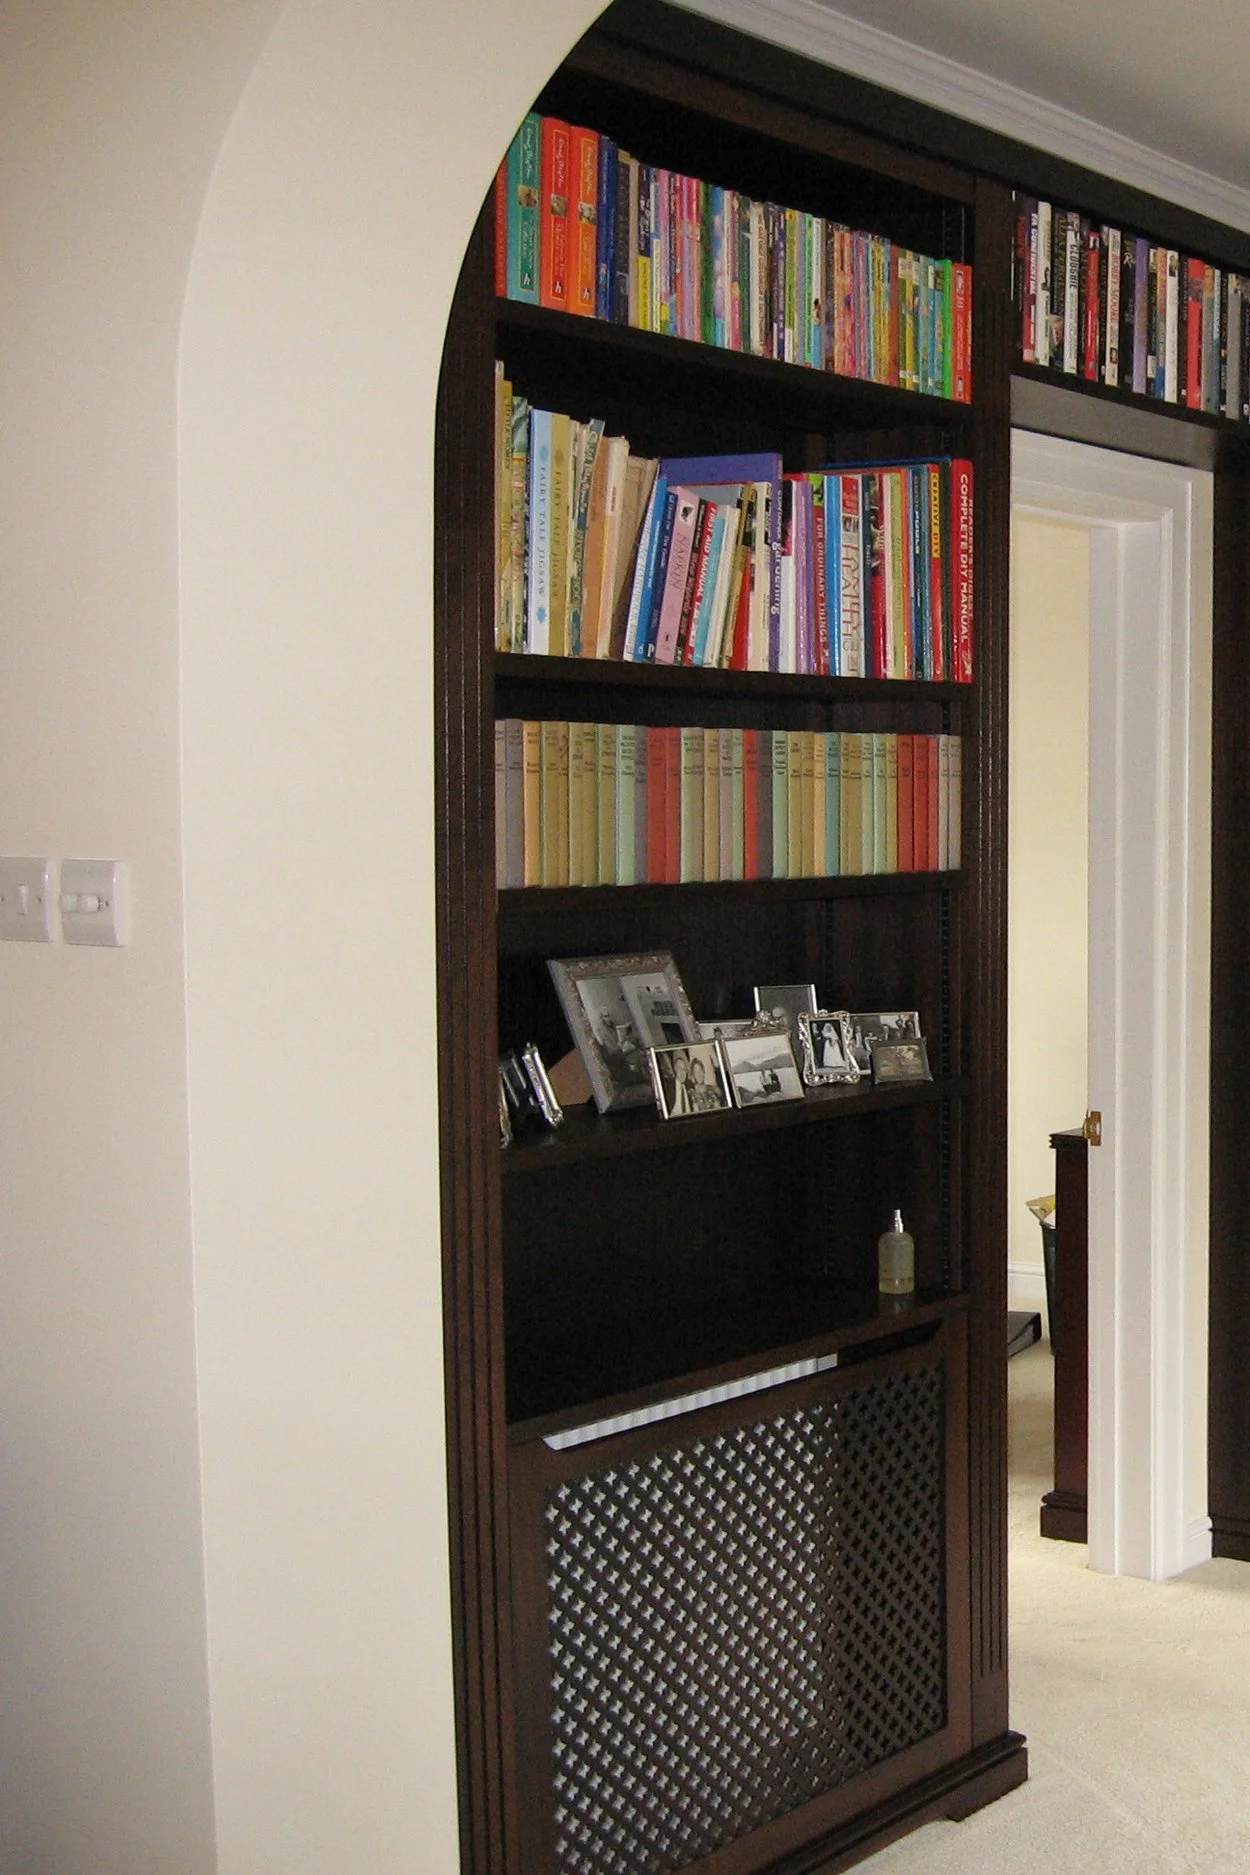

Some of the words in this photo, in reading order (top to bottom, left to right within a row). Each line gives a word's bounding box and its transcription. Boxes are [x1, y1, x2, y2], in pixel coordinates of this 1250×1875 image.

[1058, 216, 1067, 249] ALEX
[1057, 251, 1066, 315] FERGUSON
[1069, 243, 1078, 289] CLOUGHIE
[1111, 253, 1120, 287] BOBBY
[1110, 288, 1120, 324] MOORE
[538, 465, 547, 505] FAIRY
[553, 470, 562, 510] FAIRY
[931, 473, 939, 528] CREATIVE
[538, 511, 547, 541] TALE
[552, 515, 562, 545] TALE
[706, 506, 717, 533] FIRST
[816, 517, 824, 539] FOR
[960, 473, 969, 550] COMPLETE
[670, 532, 688, 591] NAPKIN
[703, 534, 712, 553] AID
[932, 532, 940, 556] DIY
[537, 546, 547, 598] JIGSAW
[551, 549, 561, 601] JIGSAW
[696, 554, 710, 598] MANUAL
[772, 541, 784, 615] gardening
[817, 541, 826, 598] ORDINARY
[960, 553, 969, 579] DIY
[842, 542, 853, 638] HEALTH
[850, 543, 860, 635] FAMILY
[819, 601, 828, 643] THINGS
[961, 582, 970, 644] MANUAL
